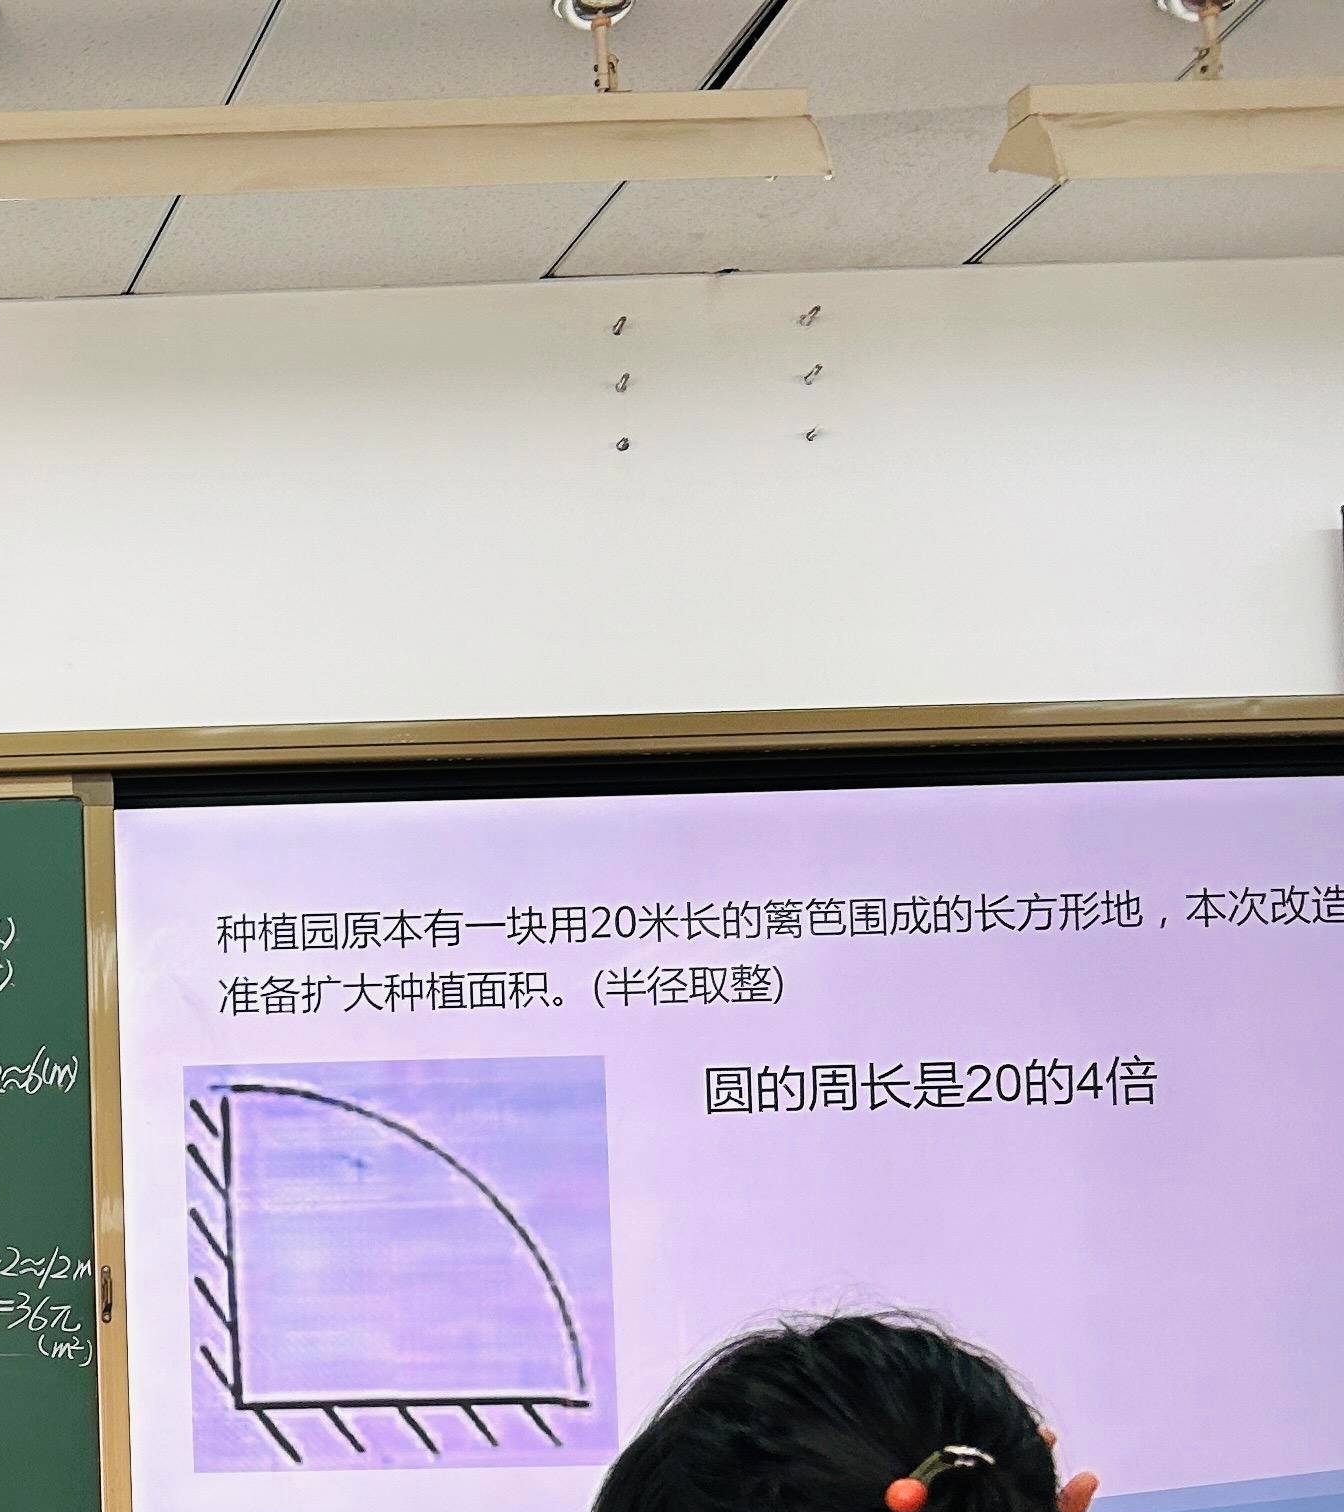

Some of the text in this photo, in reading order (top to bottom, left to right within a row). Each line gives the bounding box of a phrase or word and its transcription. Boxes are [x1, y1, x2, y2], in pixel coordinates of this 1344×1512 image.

[704, 1055, 1158, 1115] 圆的周长是20的4倍
